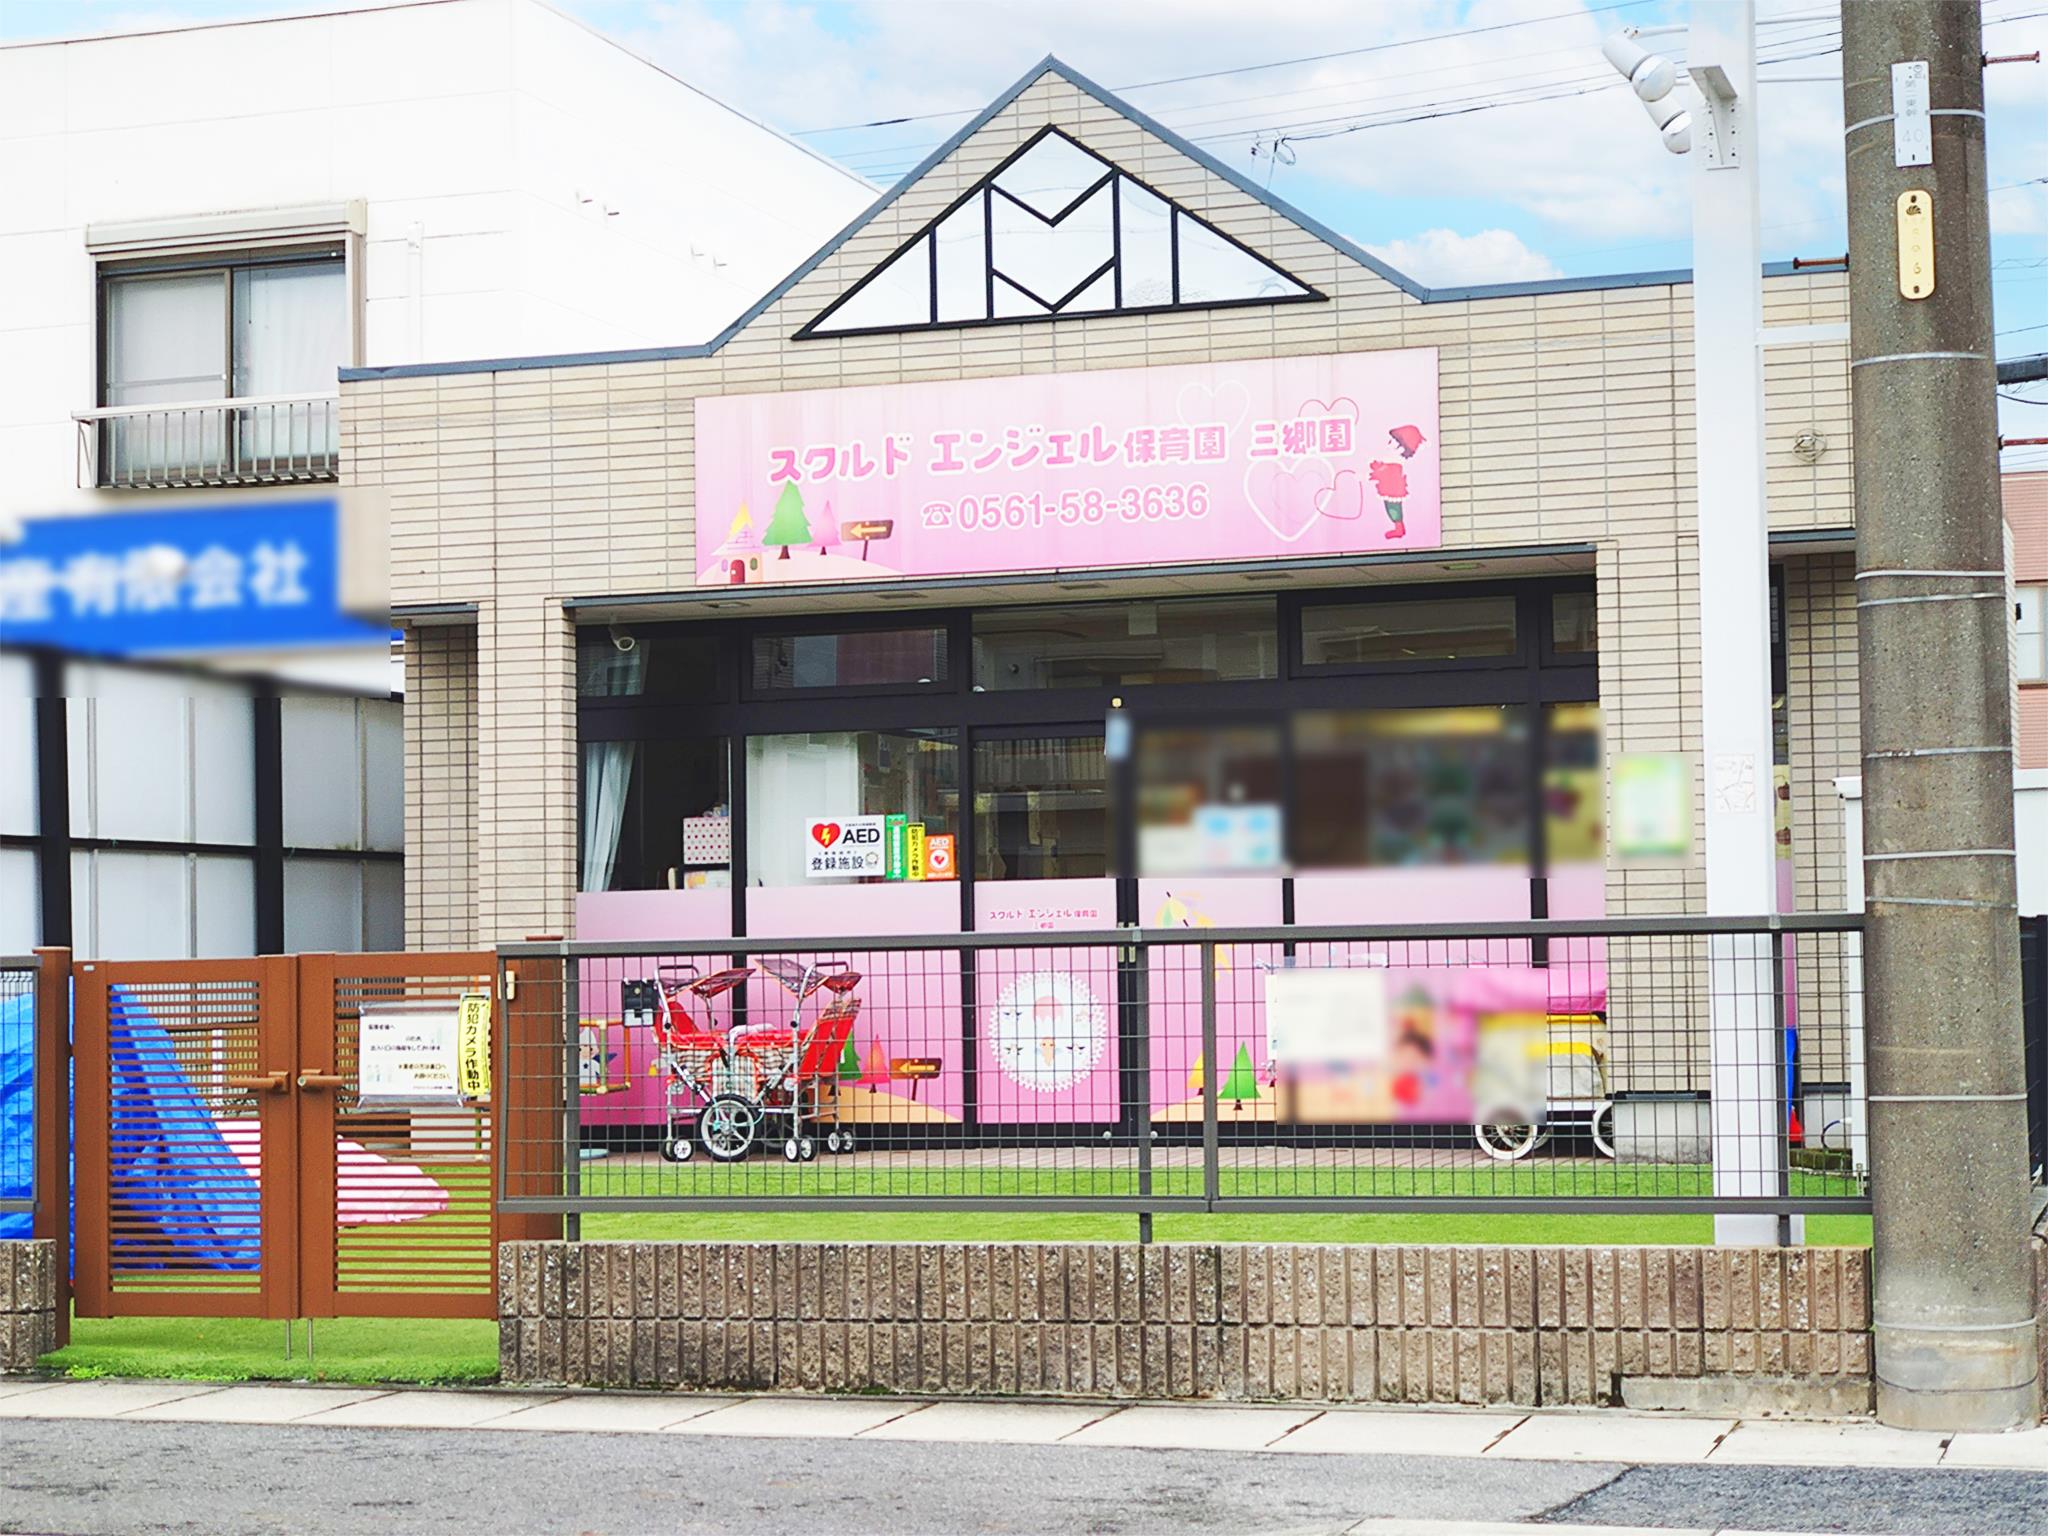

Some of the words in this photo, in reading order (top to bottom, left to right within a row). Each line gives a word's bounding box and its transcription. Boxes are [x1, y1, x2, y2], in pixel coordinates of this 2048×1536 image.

[771, 435, 912, 482] スクルド
[1250, 417, 1352, 457] 三郷園
[957, 484, 1209, 530] 0561-58-3636
[842, 828, 880, 844] AED
[812, 856, 864, 870] 登録施設
[465, 1002, 481, 1091] 防犯カメラ作動中
